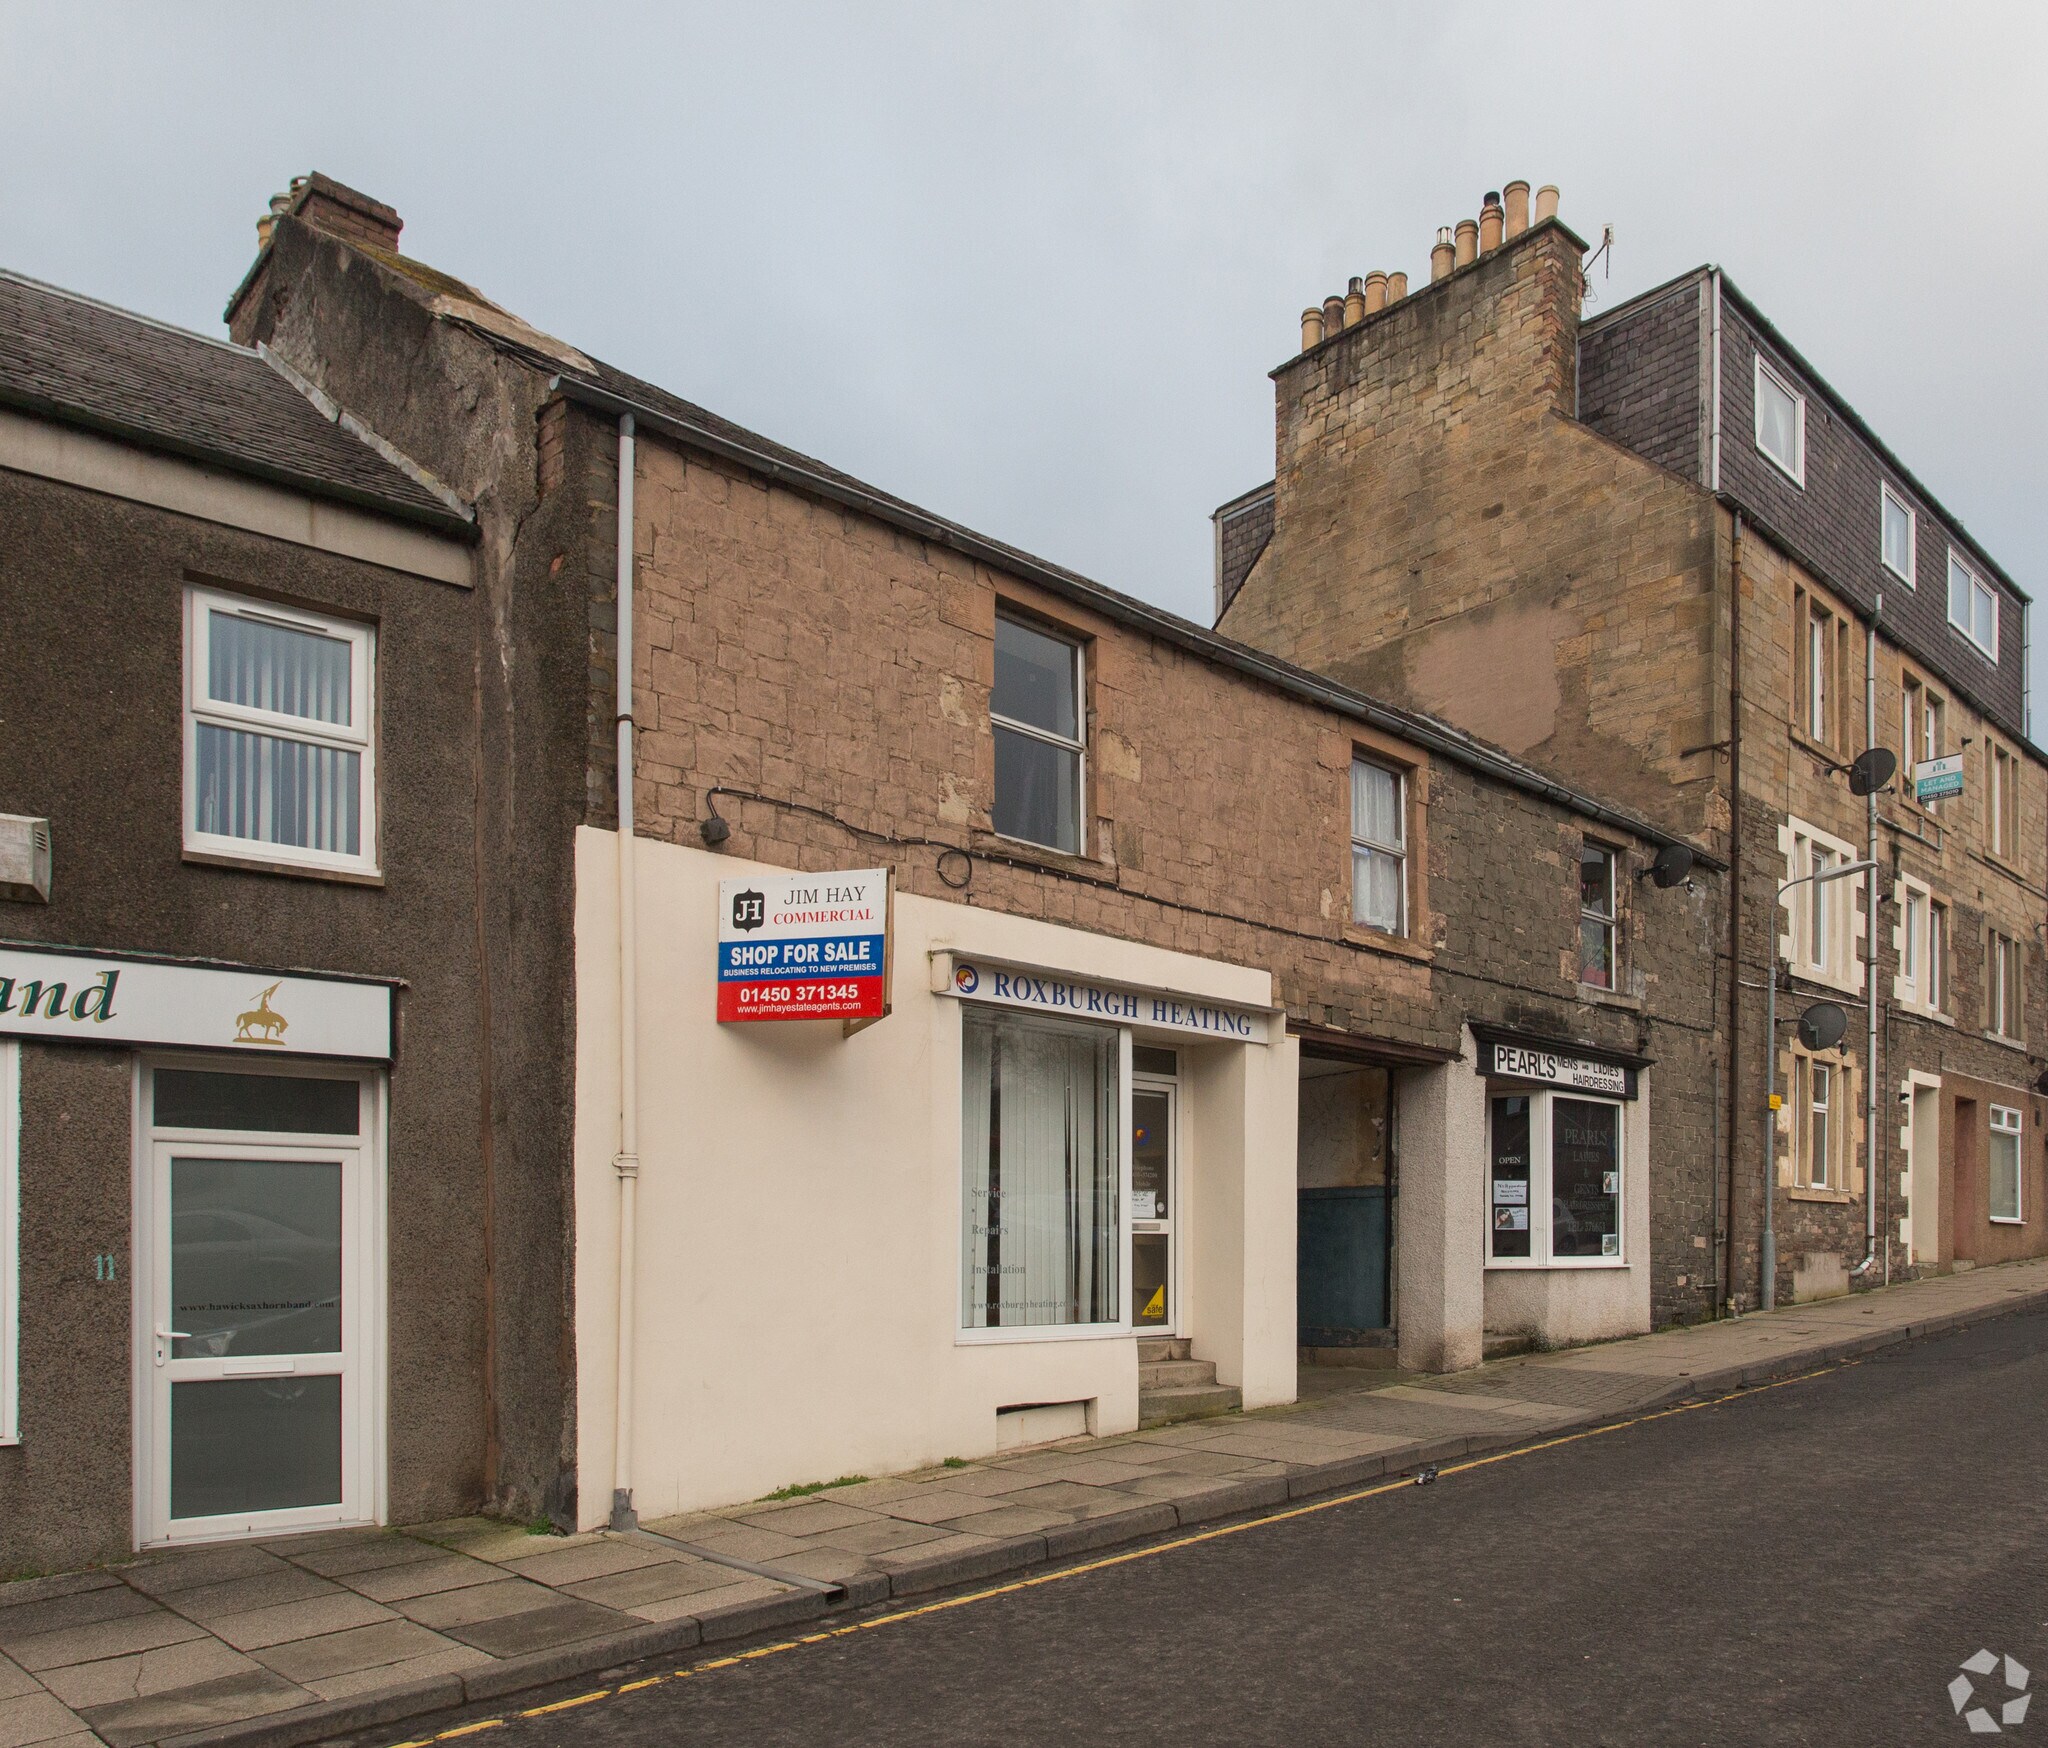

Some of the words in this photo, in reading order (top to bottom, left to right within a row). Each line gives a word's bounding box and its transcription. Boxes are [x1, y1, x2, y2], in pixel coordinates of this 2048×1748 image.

[1921, 781, 1959, 793] MANAGED
[1924, 778, 1937, 787] LET
[1940, 775, 1956, 783] AND
[783, 889, 819, 906] JIM
[826, 886, 866, 903] HAY
[773, 908, 874, 925] COMMERCIAL
[730, 945, 779, 966] SHOP
[783, 943, 819, 964] FOR
[824, 941, 870, 962] SALE
[723, 968, 759, 977] BUSINESS
[760, 966, 807, 975] RELOCATING
[808, 965, 819, 973] TO
[820, 965, 838, 973] NEW
[838, 963, 877, 972] PREMISES
[740, 987, 791, 1003] 01450
[796, 984, 859, 1001] 371345
[737, 1002, 861, 1014] www.jimhayestateagents.com
[993, 971, 1139, 1018] ROXBURGH
[1151, 998, 1252, 1036] HEATING
[1496, 1046, 1556, 1079] PEARL'S
[1593, 1063, 1619, 1078] LADIES
[1572, 1073, 1624, 1092] HAIRDRESSING
[1498, 1156, 1521, 1164] OPEN
[971, 1187, 1007, 1198] Service
[971, 1224, 1009, 1237] Repairs
[93, 1253, 115, 1281] 11
[971, 1264, 1026, 1274] Installation
[179, 1300, 335, 1312] www.hawicksaxhornband.com
